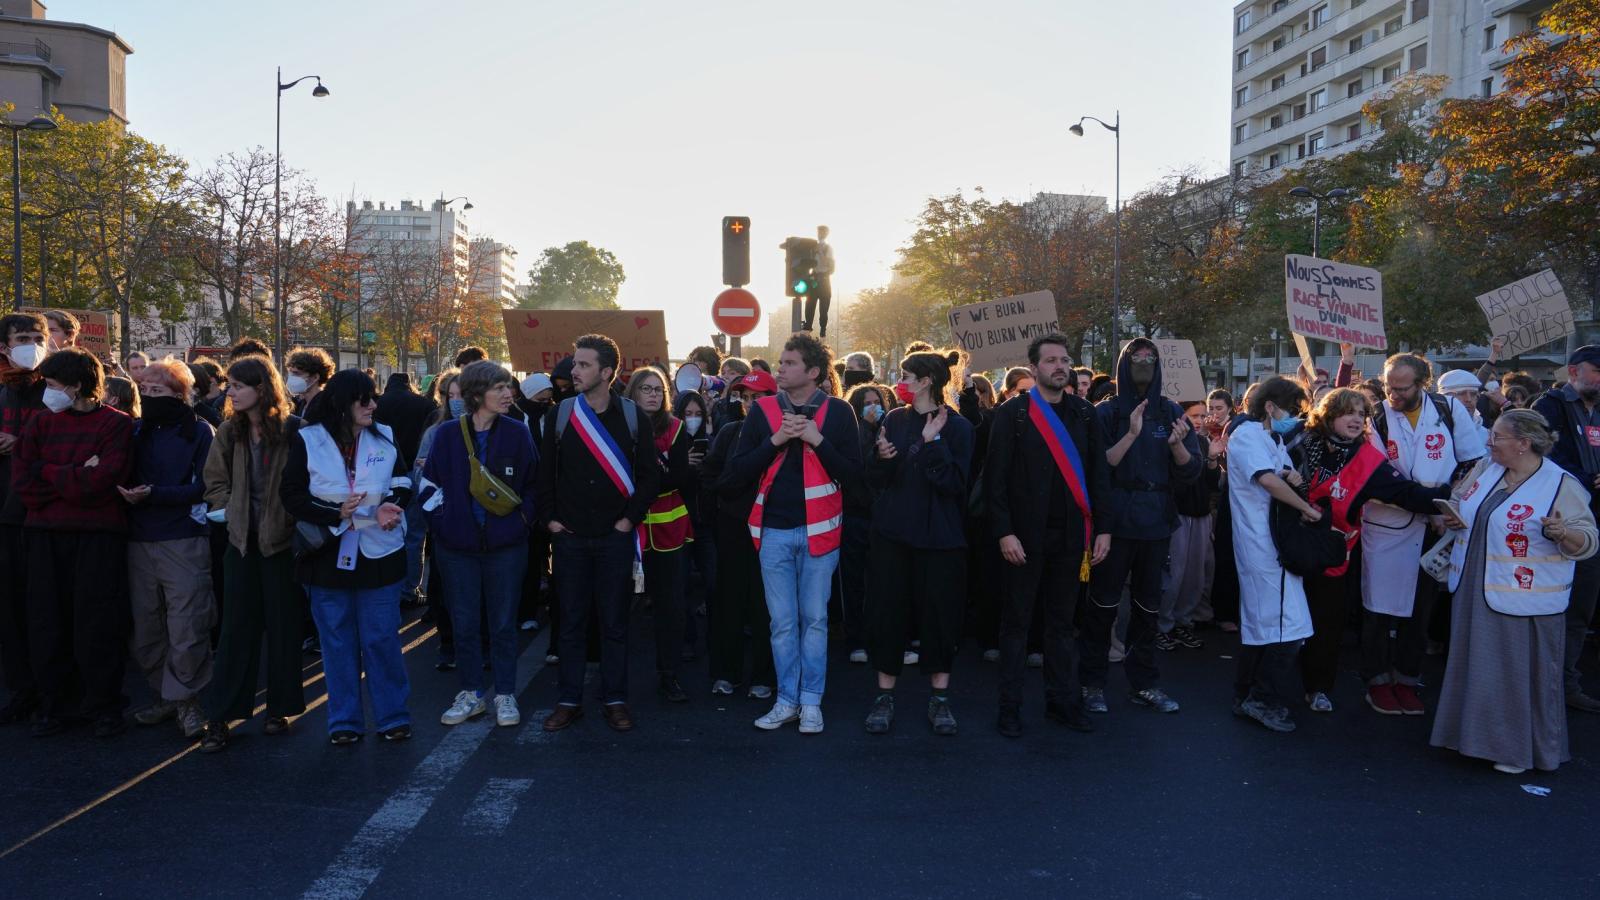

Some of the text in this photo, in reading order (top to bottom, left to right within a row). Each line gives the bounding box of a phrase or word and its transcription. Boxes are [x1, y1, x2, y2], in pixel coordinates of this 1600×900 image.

[1293, 287, 1325, 310] RAGE
[1316, 283, 1341, 301] LA
[949, 312, 961, 327] IF
[969, 306, 990, 323] WE
[1319, 310, 1347, 326] D'UN
[1293, 314, 1335, 338] MONDE
[956, 329, 983, 351] YOU
[987, 326, 1017, 346] BURN
[1018, 322, 1044, 340] WITH
[1162, 344, 1178, 356] DE
[1160, 358, 1193, 369] NGUES
[1427, 451, 1443, 461] cgt
[1506, 522, 1525, 533] cgt
